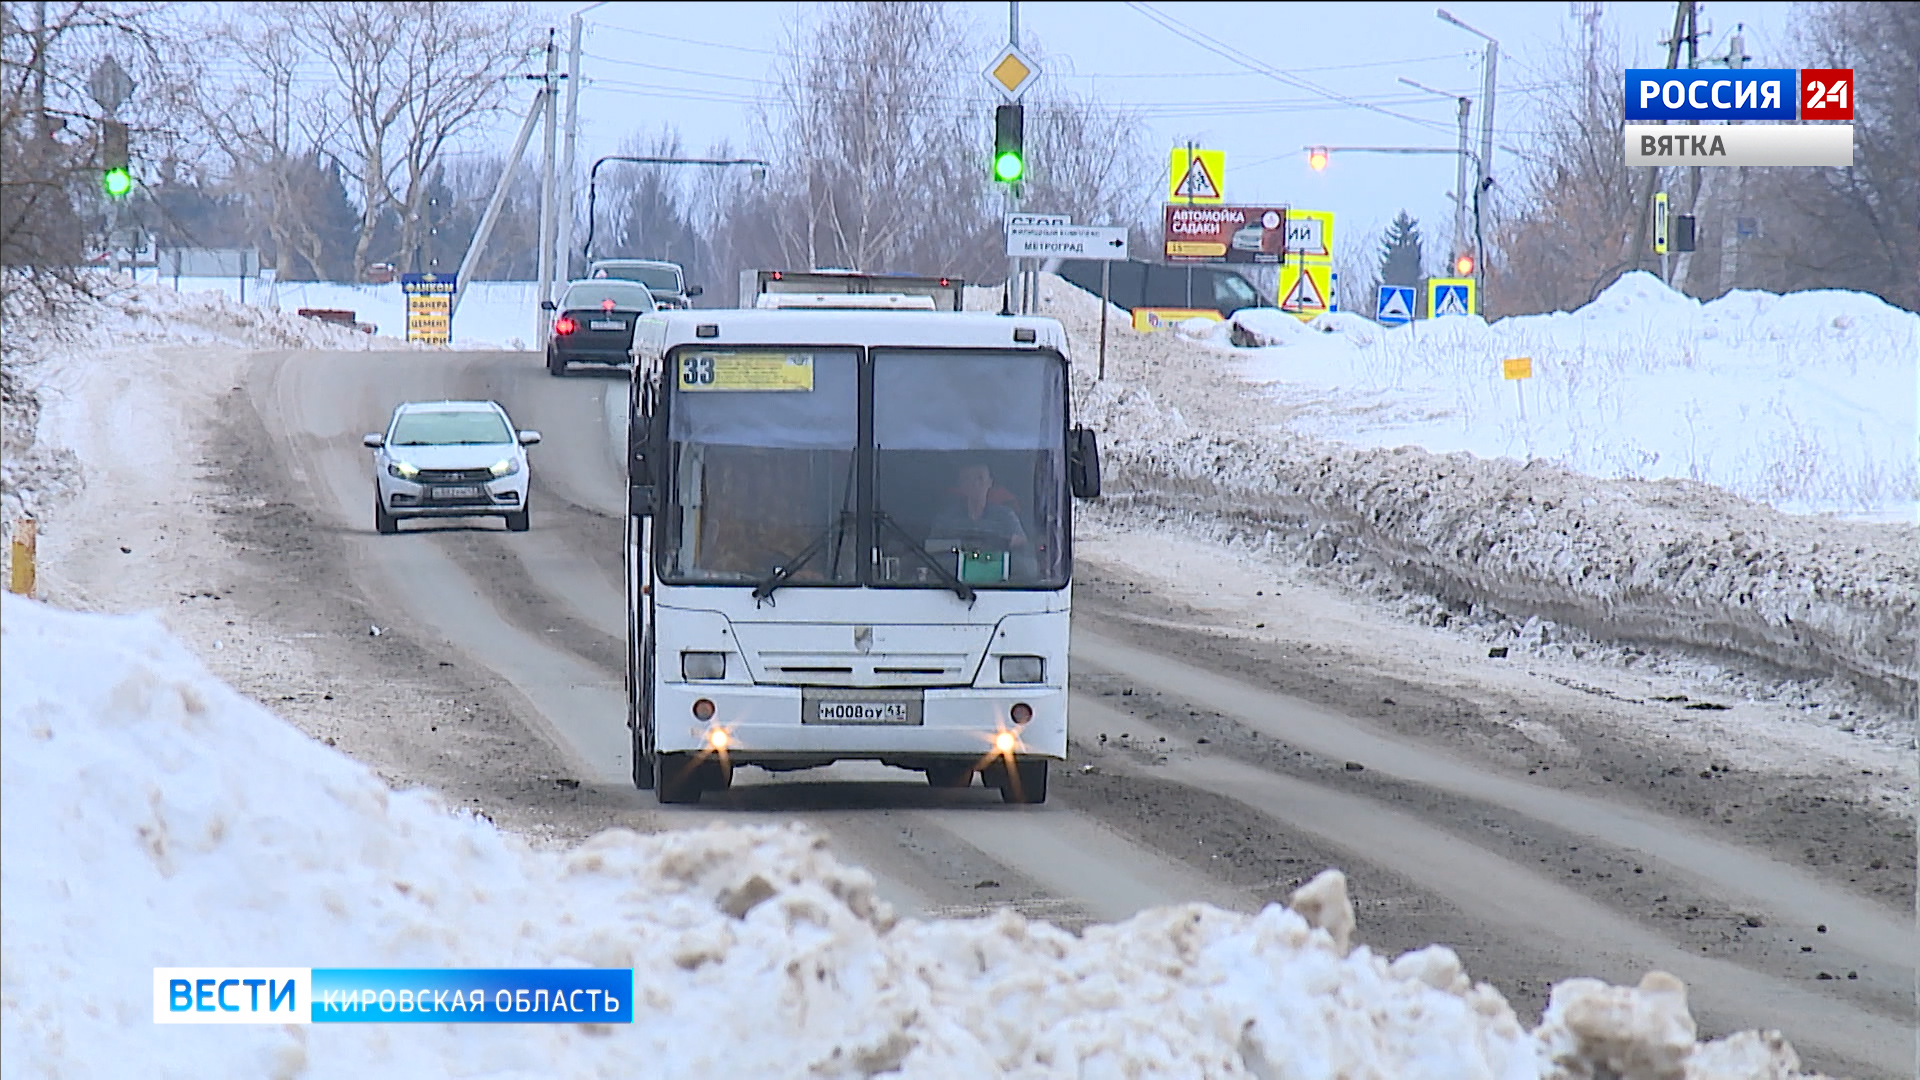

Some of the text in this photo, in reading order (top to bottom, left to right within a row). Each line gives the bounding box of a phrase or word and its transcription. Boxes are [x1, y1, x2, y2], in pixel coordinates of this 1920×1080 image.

[1172, 207, 1245, 223] АВТОМОЙКА
[1172, 222, 1220, 235] САДАКИ
[1024, 241, 1084, 253] МЕТРОГРАД
[411, 319, 447, 328] ЦЕМЕНТ
[683, 357, 715, 385] 33
[824, 705, 883, 719] М008ОУ
